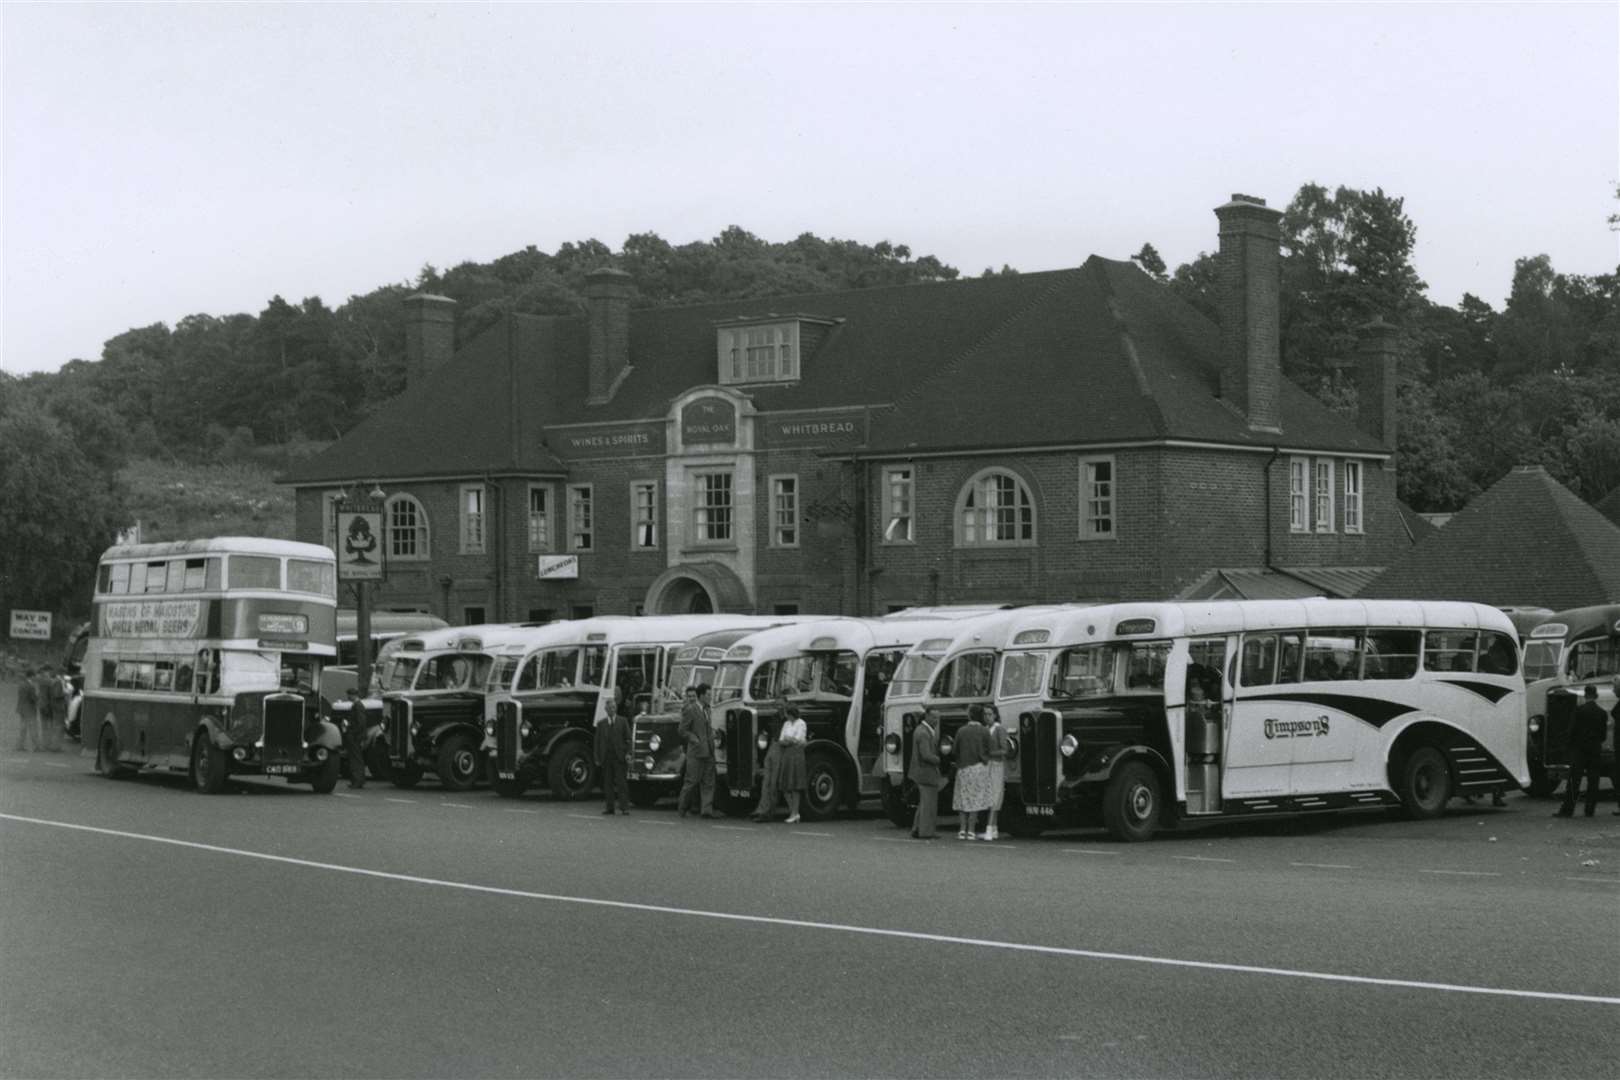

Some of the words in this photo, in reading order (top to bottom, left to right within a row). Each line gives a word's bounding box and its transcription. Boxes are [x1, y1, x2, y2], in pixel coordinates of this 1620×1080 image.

[712, 423, 729, 433] OAK
[781, 421, 855, 435] WHITBREAD
[570, 436, 603, 448] WINES
[611, 432, 649, 446] SPIRITS
[15, 613, 36, 622] WAY
[38, 615, 48, 623] IN
